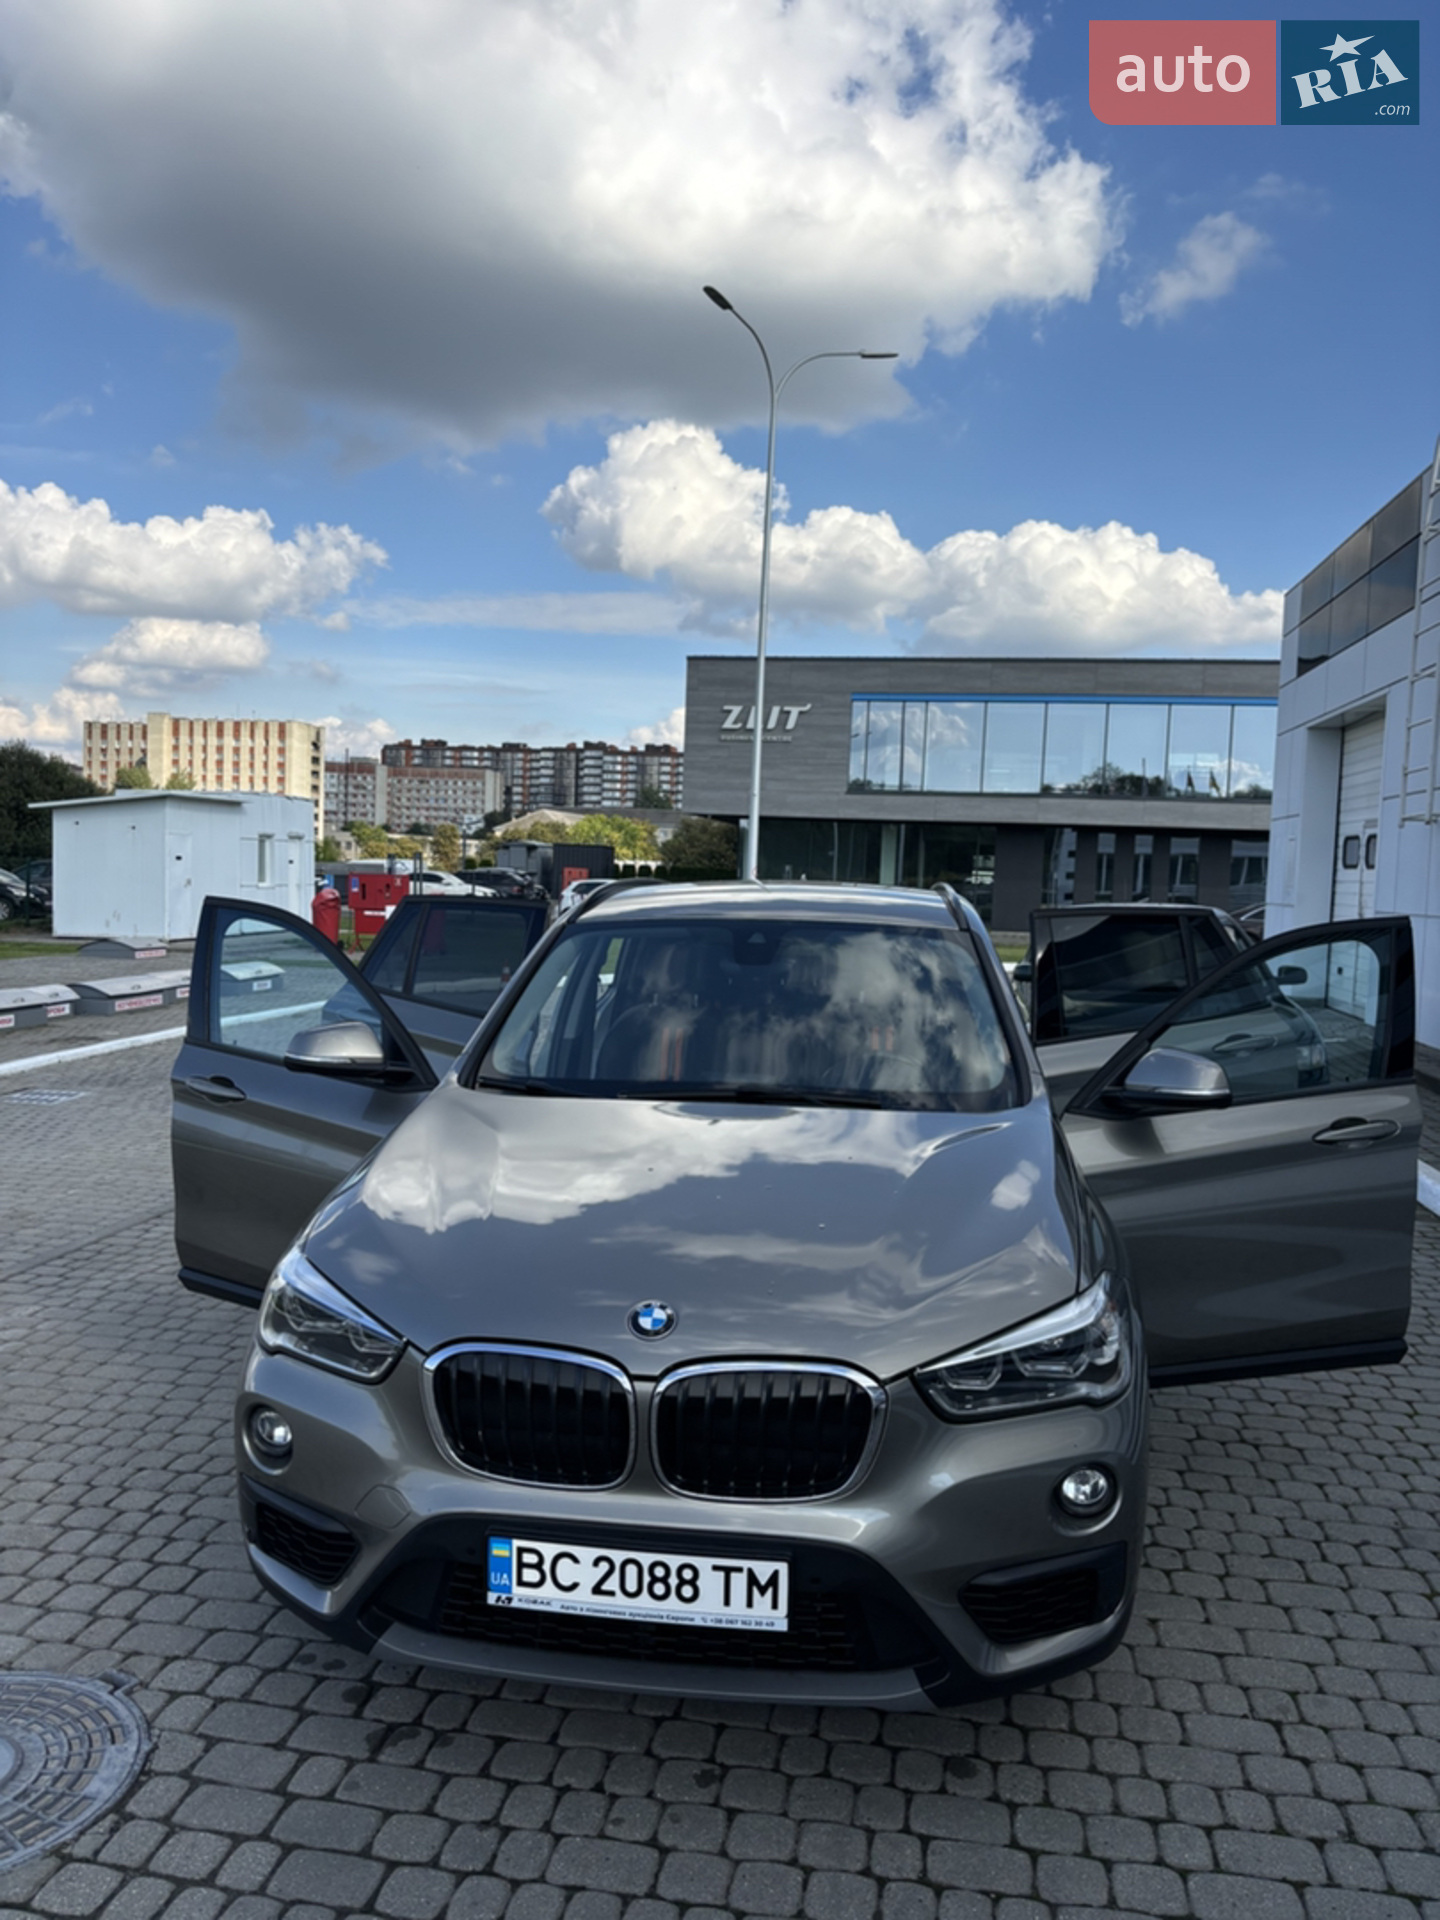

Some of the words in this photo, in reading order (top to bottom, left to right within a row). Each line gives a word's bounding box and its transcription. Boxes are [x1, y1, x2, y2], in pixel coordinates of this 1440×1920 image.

[490, 1571, 511, 1587] UA
[516, 1546, 581, 1593] BC
[591, 1555, 700, 1604] 2088
[711, 1564, 780, 1611] TM
